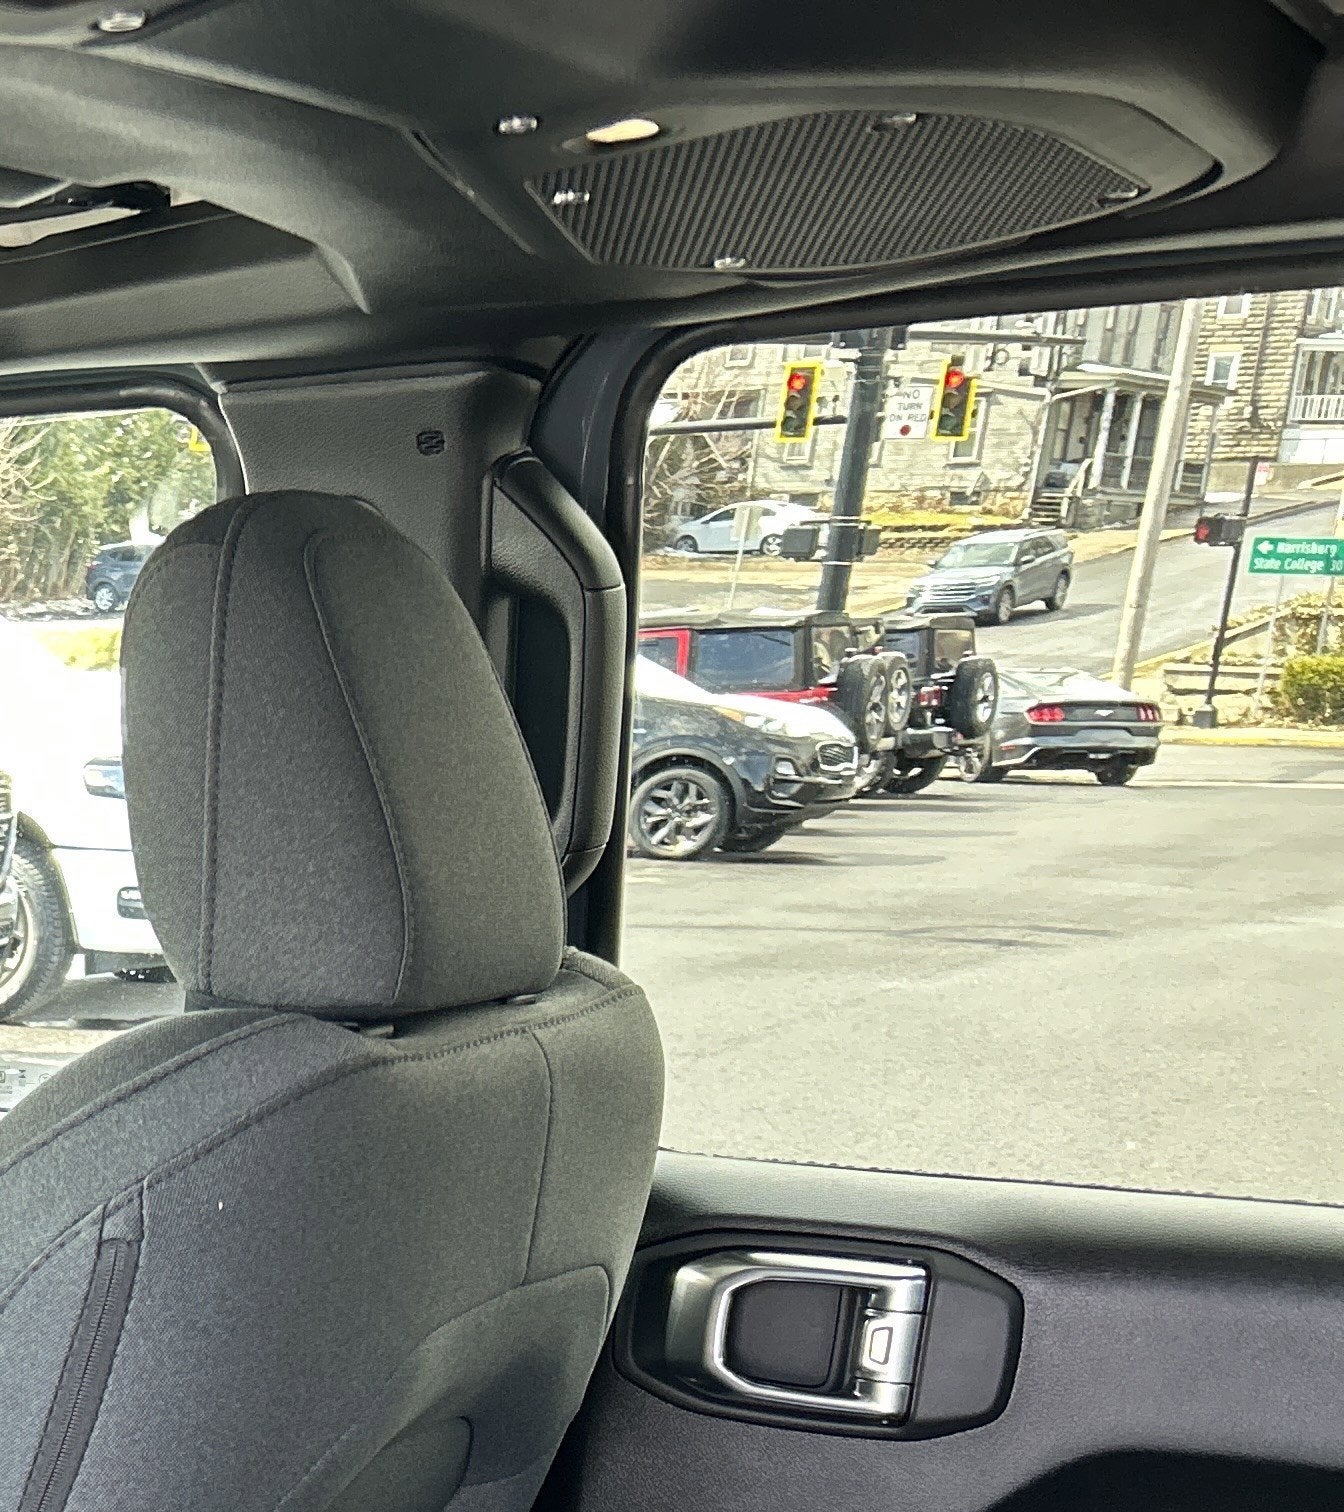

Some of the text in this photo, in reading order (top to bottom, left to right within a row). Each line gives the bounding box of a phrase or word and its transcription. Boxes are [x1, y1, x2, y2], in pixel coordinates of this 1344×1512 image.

[903, 389, 920, 399] NO
[898, 402, 923, 410] TURN
[889, 413, 926, 422] ON RED
[1276, 542, 1337, 557] Harrisburg
[1253, 558, 1281, 570] State
[1283, 558, 1324, 573] College
